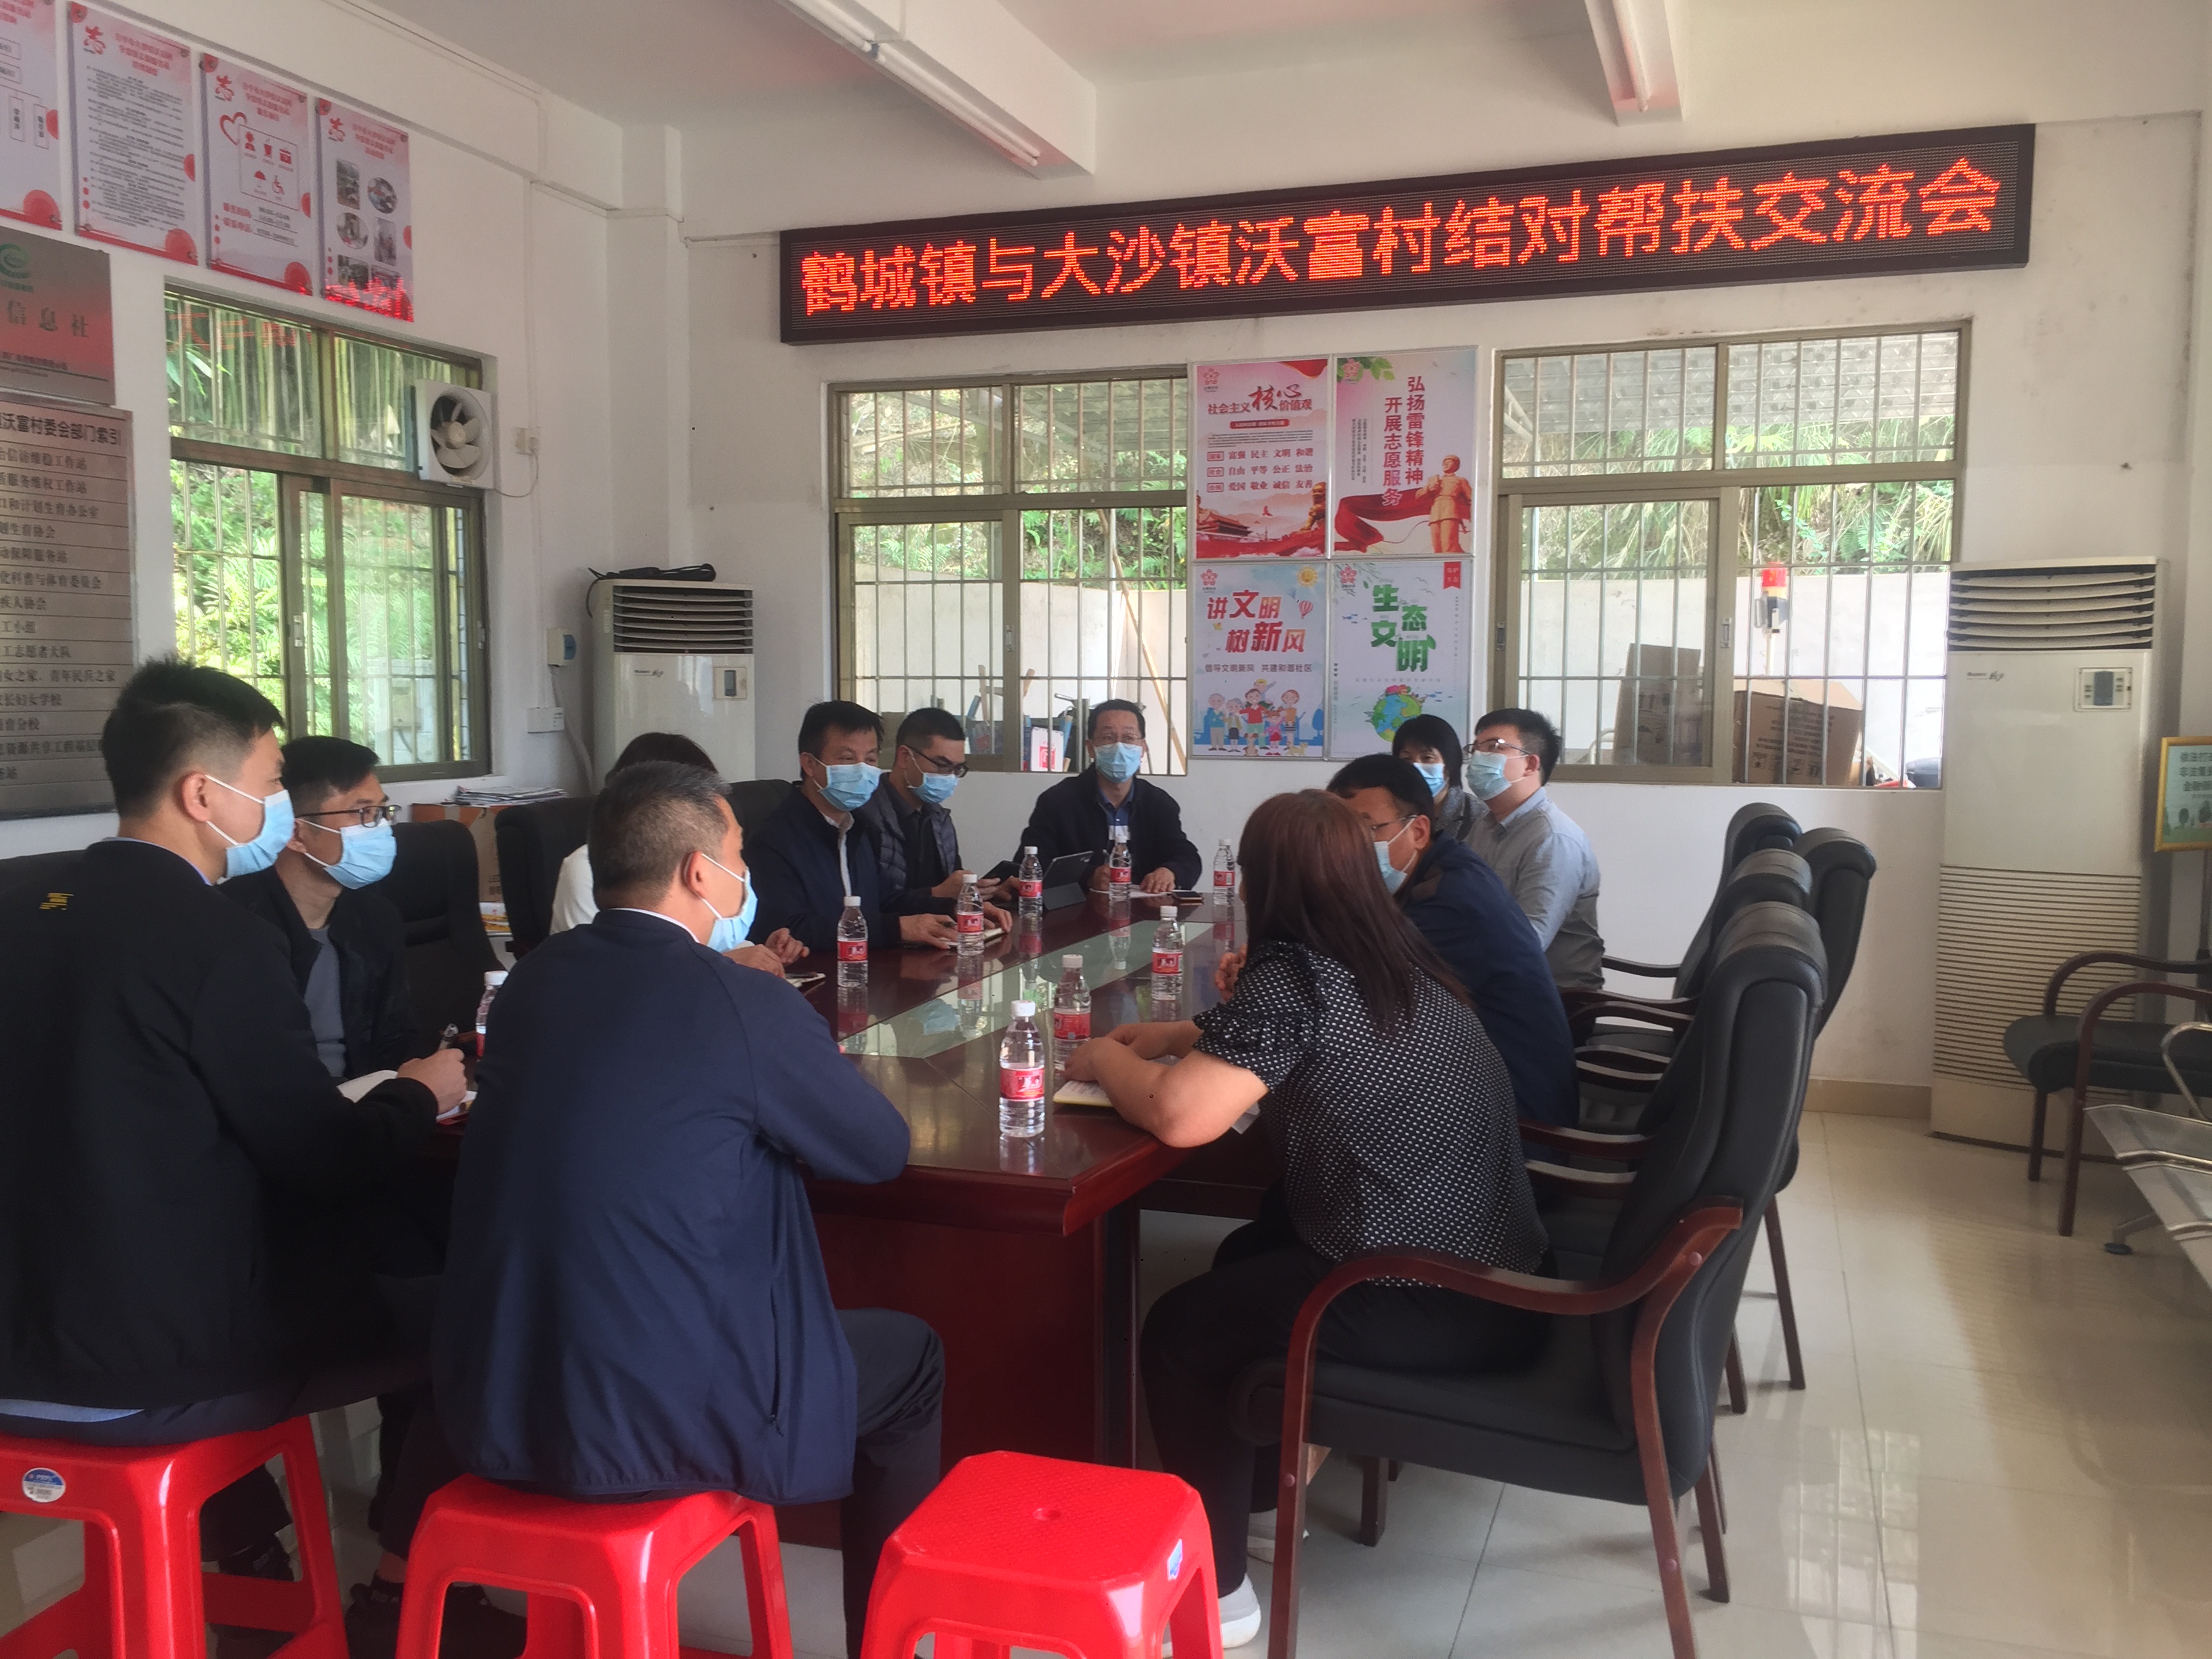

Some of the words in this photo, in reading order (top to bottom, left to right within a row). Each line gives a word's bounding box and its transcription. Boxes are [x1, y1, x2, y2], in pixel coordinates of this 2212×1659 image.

[801, 157, 2001, 316] 鹤城镇与大沙镇沃富村结对帮扶交流会
[1208, 384, 1313, 415] 社会主义核心价值观
[0, 411, 121, 446] 沃富村委会部门索引
[1405, 375, 1426, 485] 弘扬雷锋精神
[1228, 451, 1246, 459] 富强
[1251, 450, 1268, 459] 民主
[1274, 449, 1291, 457] 文明
[1382, 396, 1403, 506] 开展志愿服务
[1228, 482, 1246, 491] 爱国
[1250, 481, 1268, 490] 敬业
[1273, 480, 1290, 489] 诚信
[1229, 466, 1245, 475] 自由
[1250, 466, 1267, 474] 平等
[1273, 465, 1290, 474] 公正
[1206, 590, 1282, 620] 讲文明
[1225, 621, 1307, 653] 树新风
